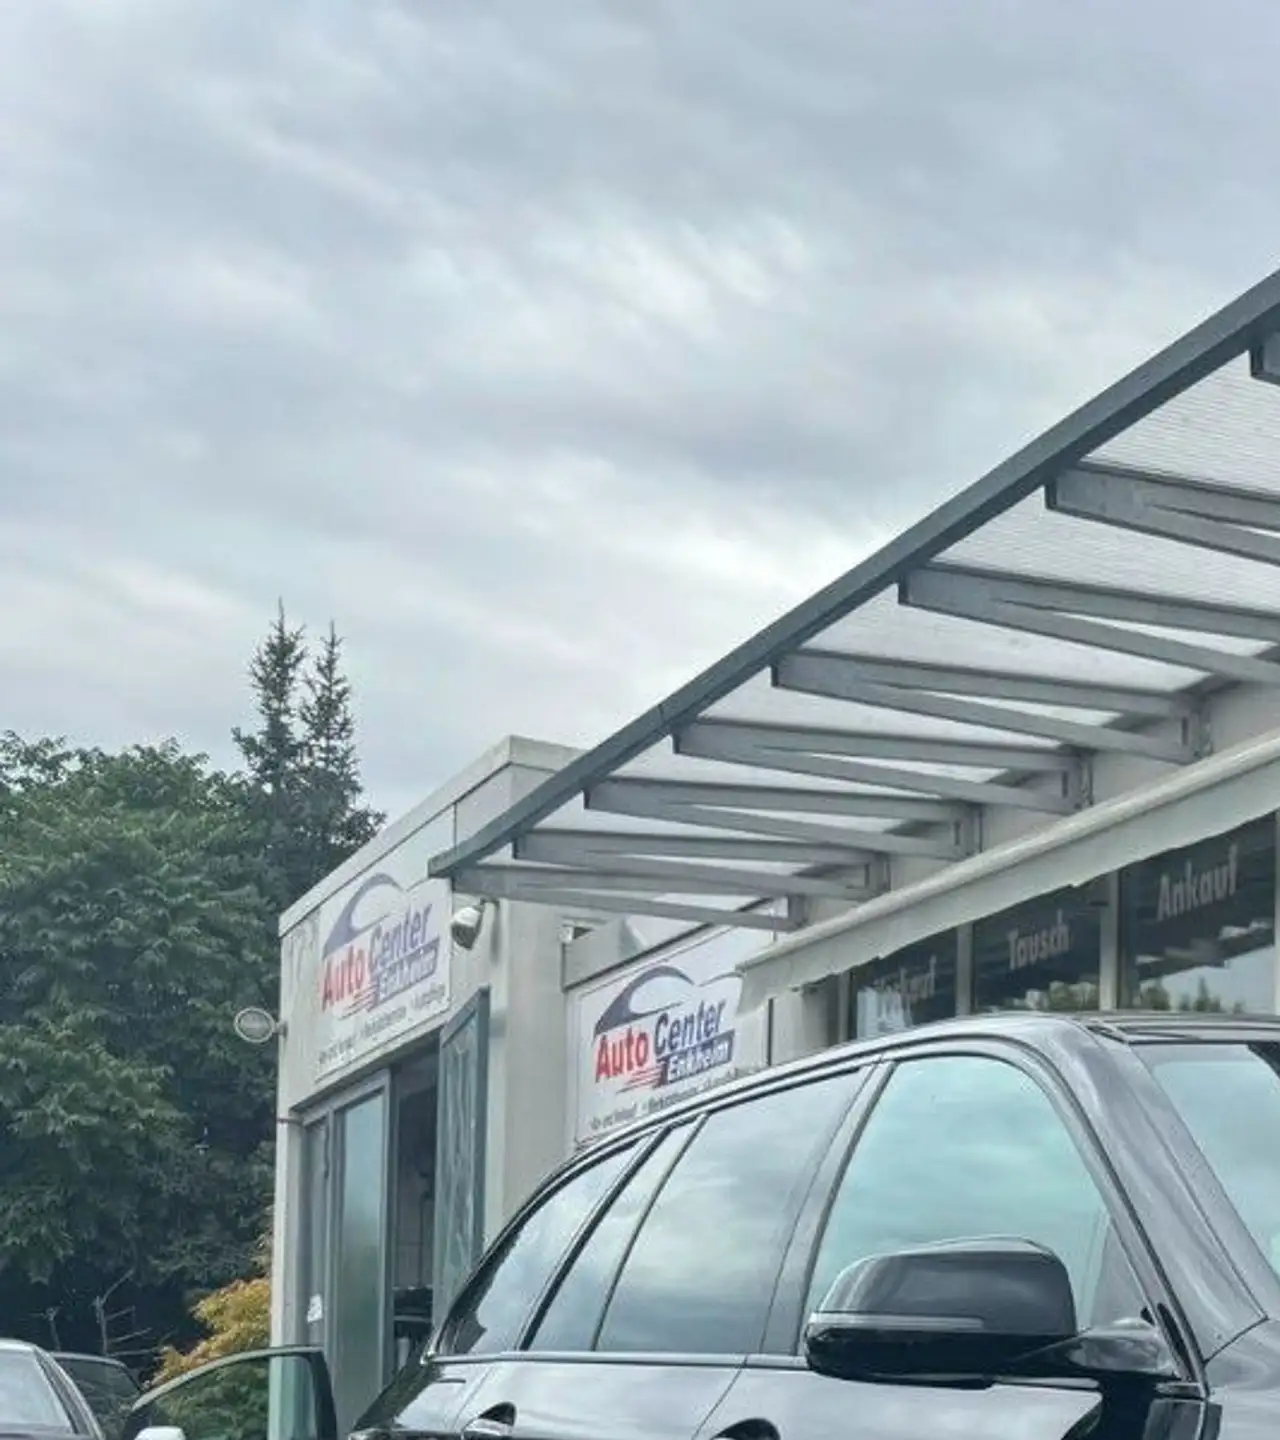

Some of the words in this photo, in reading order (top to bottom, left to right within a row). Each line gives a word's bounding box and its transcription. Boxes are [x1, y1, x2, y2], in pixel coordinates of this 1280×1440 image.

[1157, 843, 1239, 921] Ankauf
[322, 944, 366, 1013] Auto
[369, 904, 433, 973] Center
[1007, 908, 1071, 970] Tausch
[595, 1027, 649, 1084] Auto
[655, 999, 726, 1056] Center
